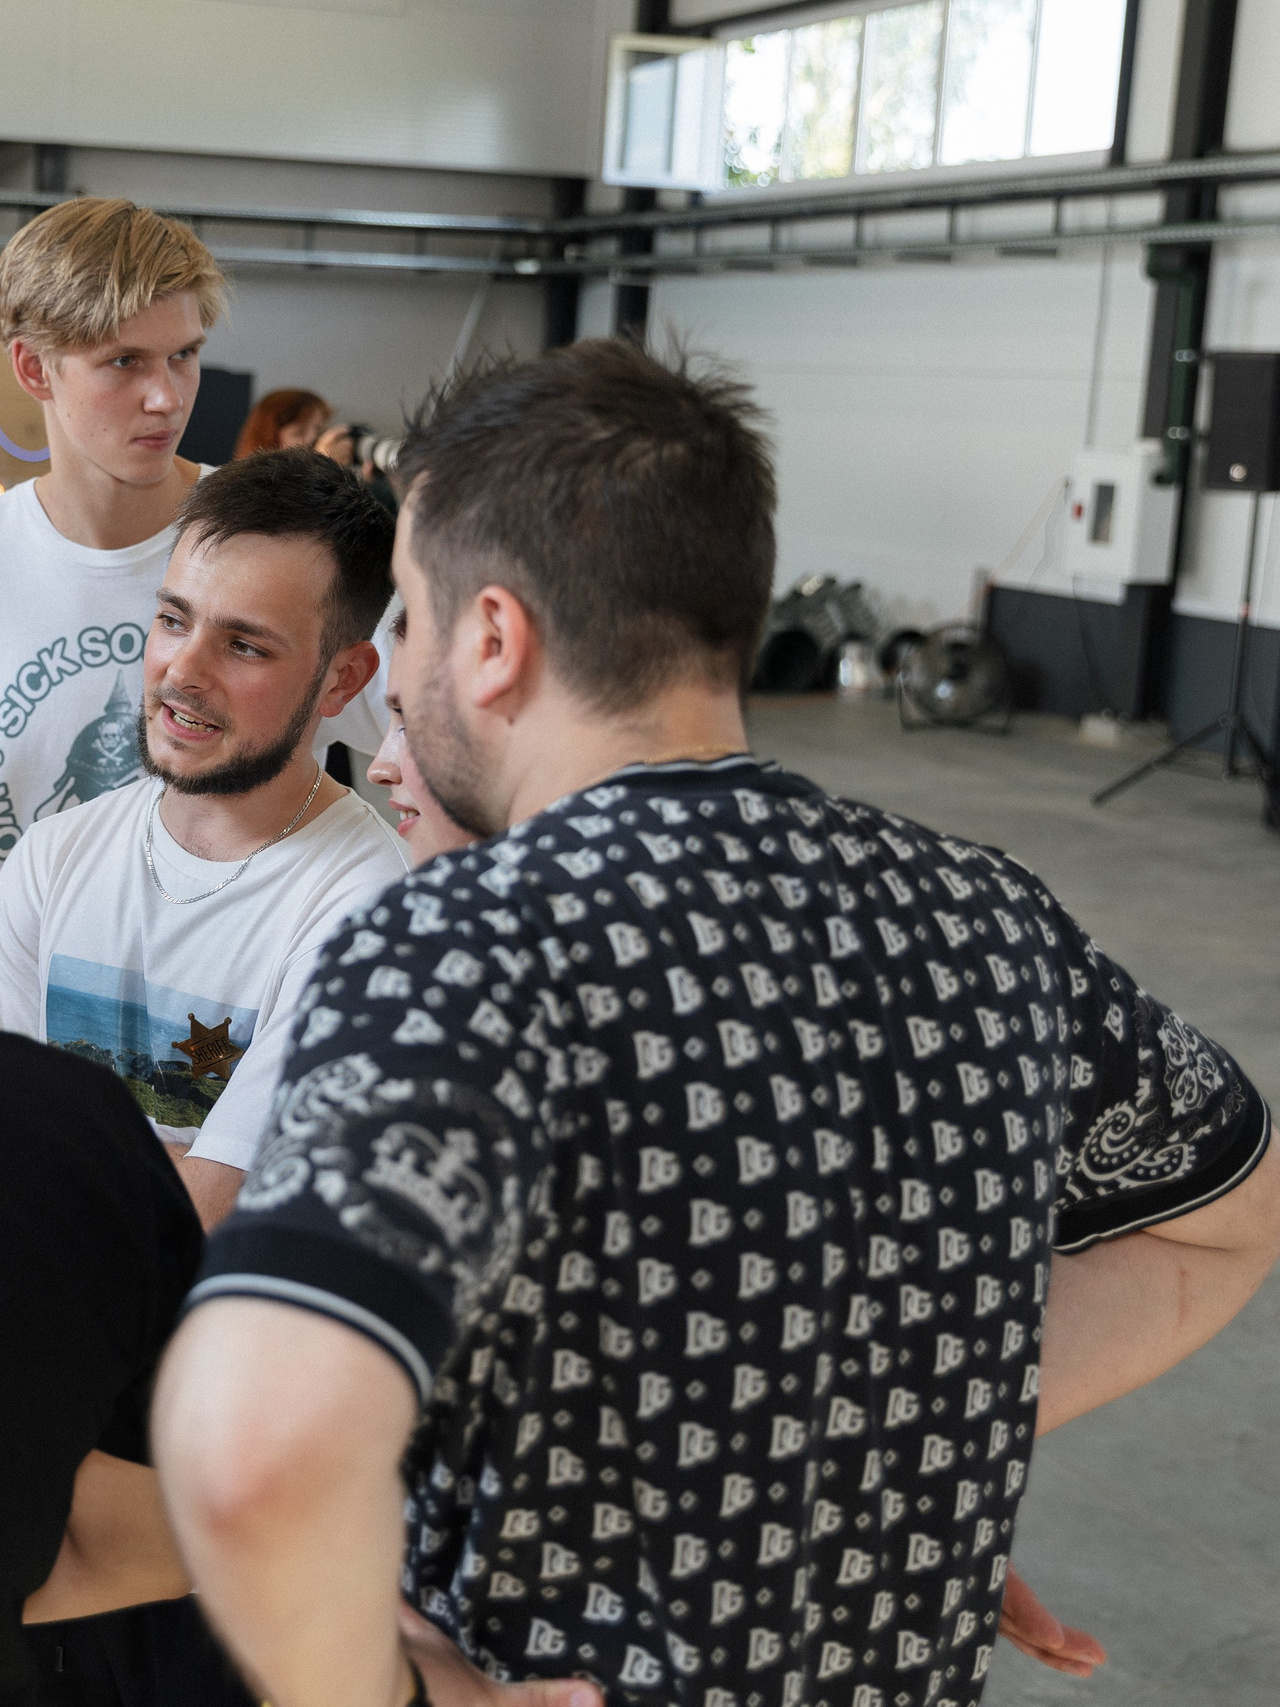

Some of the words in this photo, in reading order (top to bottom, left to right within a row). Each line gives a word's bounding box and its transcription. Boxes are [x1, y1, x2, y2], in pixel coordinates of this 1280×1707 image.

[78, 622, 147, 668] SO
[190, 1036, 229, 1064] SHERIFF
[1070, 1055, 1093, 1089] DG
